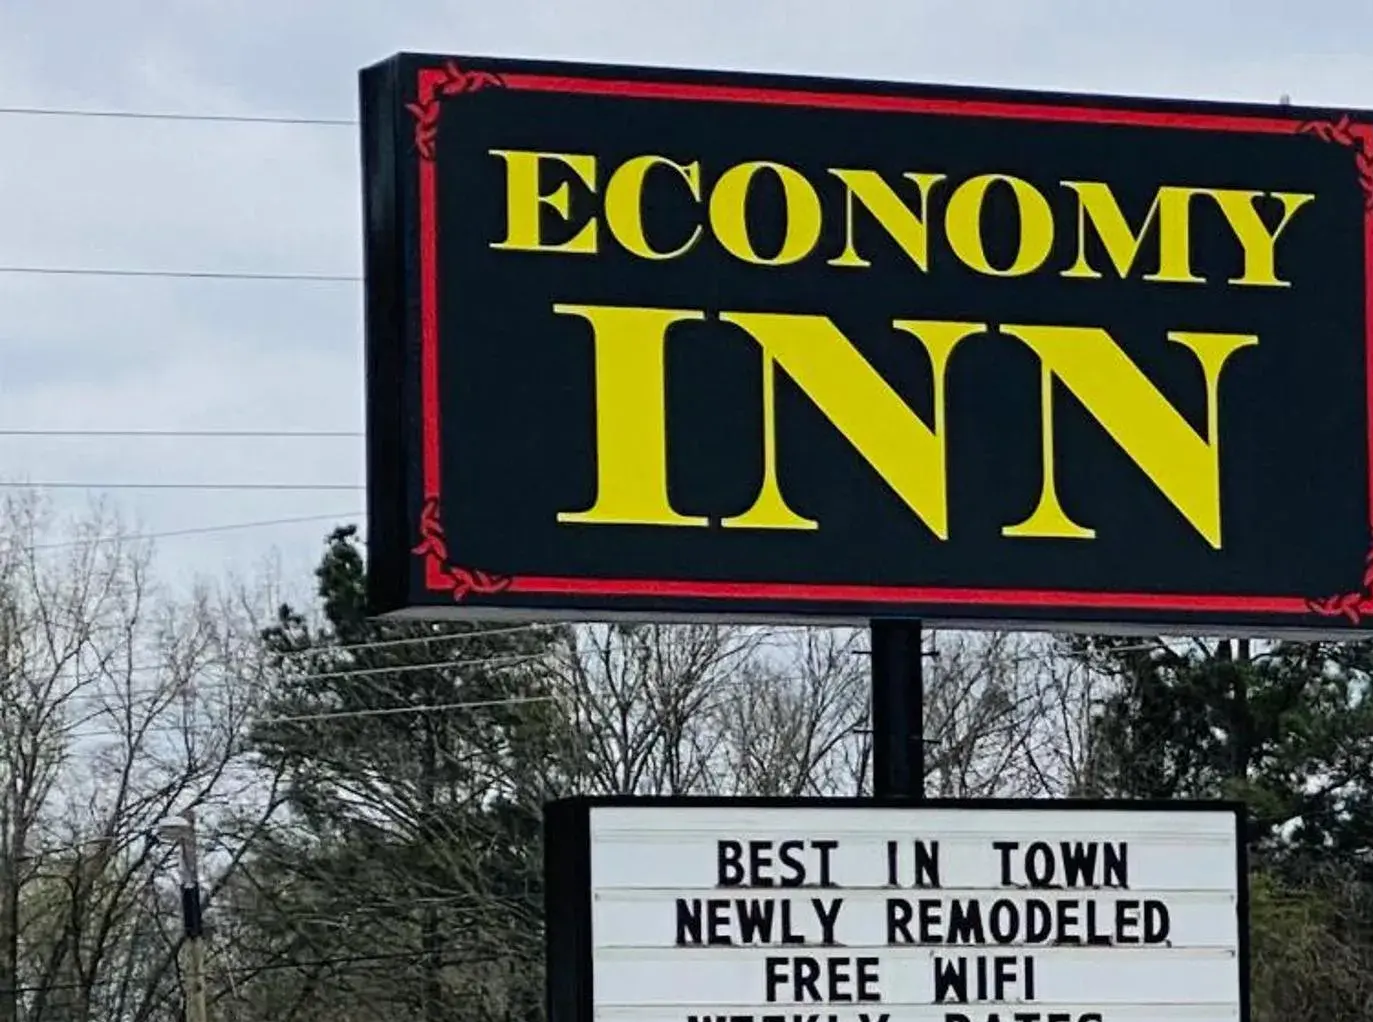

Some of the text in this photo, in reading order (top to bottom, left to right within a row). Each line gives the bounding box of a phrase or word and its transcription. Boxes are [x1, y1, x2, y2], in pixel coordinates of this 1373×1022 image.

[488, 147, 1315, 288] ECONOMY
[553, 303, 1259, 550] INN
[717, 840, 1129, 889] BEST IN TOWN
[675, 898, 1170, 946] NEWLY REMODELED
[765, 955, 1035, 1002] FREE WIFI
